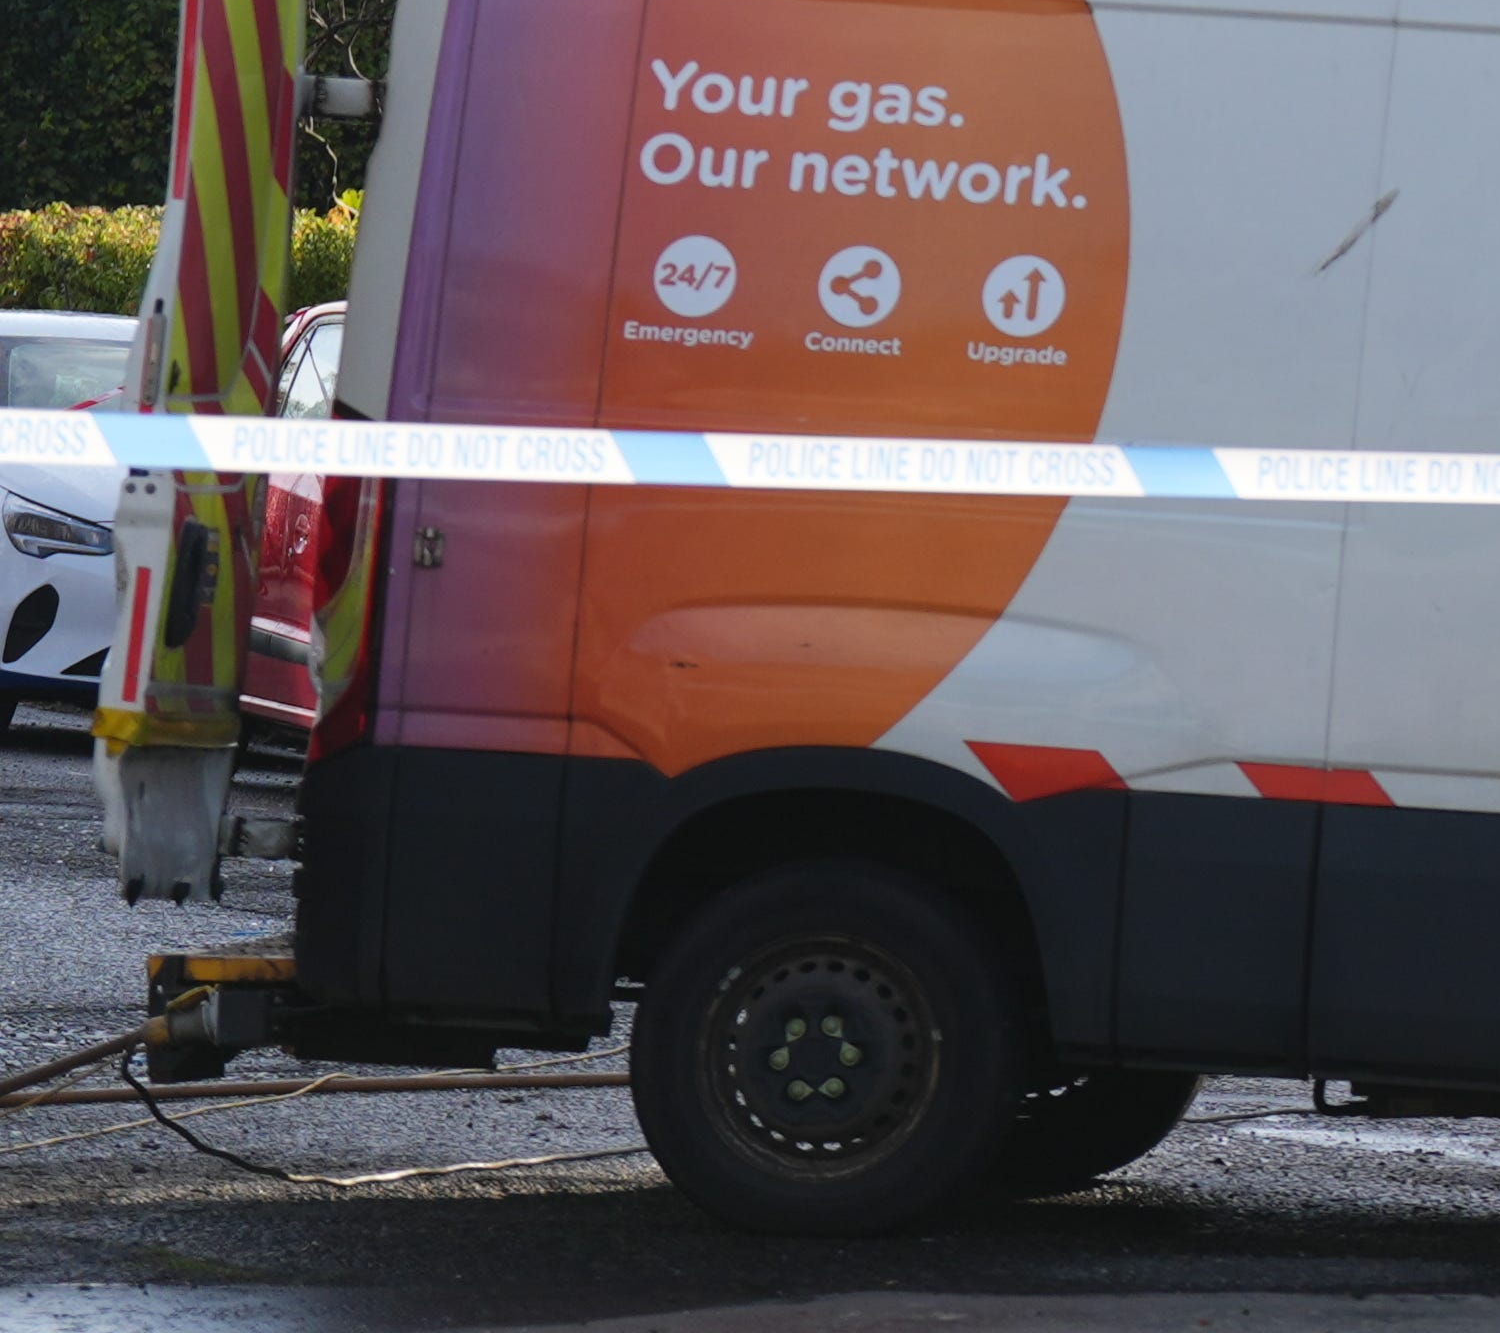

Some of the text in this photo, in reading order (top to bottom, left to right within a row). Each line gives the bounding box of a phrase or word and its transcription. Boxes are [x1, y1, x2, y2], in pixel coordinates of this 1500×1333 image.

[651, 58, 964, 132] Your gas.
[640, 132, 1087, 209] Our network.
[659, 261, 731, 291] 24/7
[623, 320, 754, 350] Emergency
[804, 331, 901, 356] Connect
[967, 341, 1067, 366] Upgrade
[232, 425, 604, 473] POLICE LINE DO NOT CROSS
[749, 442, 1116, 487] POLICE LINE DO NOT CROSS
[1260, 455, 1348, 491] POLICE
[1360, 458, 1415, 493] LINE
[1427, 460, 1459, 494] DO
